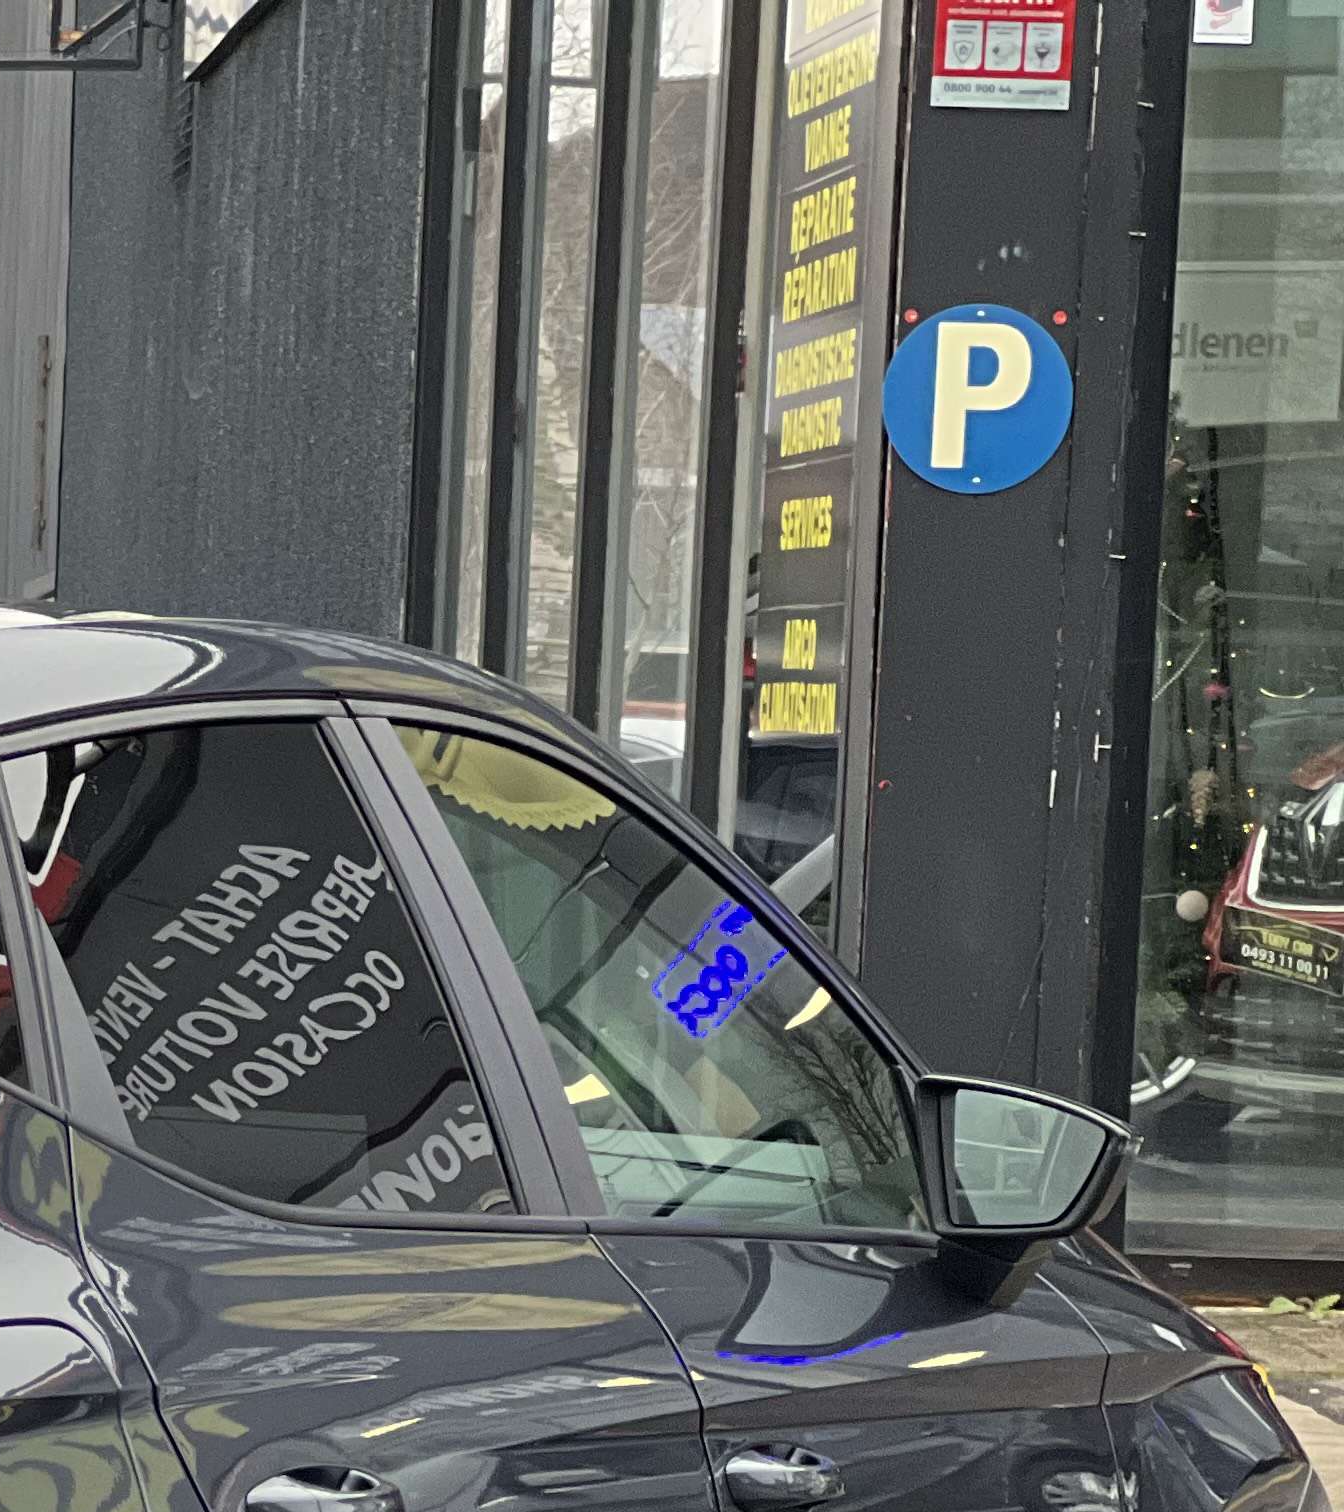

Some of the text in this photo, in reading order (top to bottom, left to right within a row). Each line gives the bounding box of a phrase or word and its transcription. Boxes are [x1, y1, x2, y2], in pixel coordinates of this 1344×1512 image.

[805, 104, 852, 173] VIDANGE
[791, 176, 856, 254] REPARATIE
[931, 322, 1032, 468] P
[780, 396, 842, 458] DIAGNOSTIC
[780, 495, 832, 551] SERVICES
[782, 619, 816, 671] AIRCO
[759, 681, 836, 735] CLIMATISATION
[1241, 944, 1275, 964] 0493
[1279, 953, 1293, 969] 11
[1296, 959, 1312, 975] 00
[1315, 964, 1329, 980] 11
